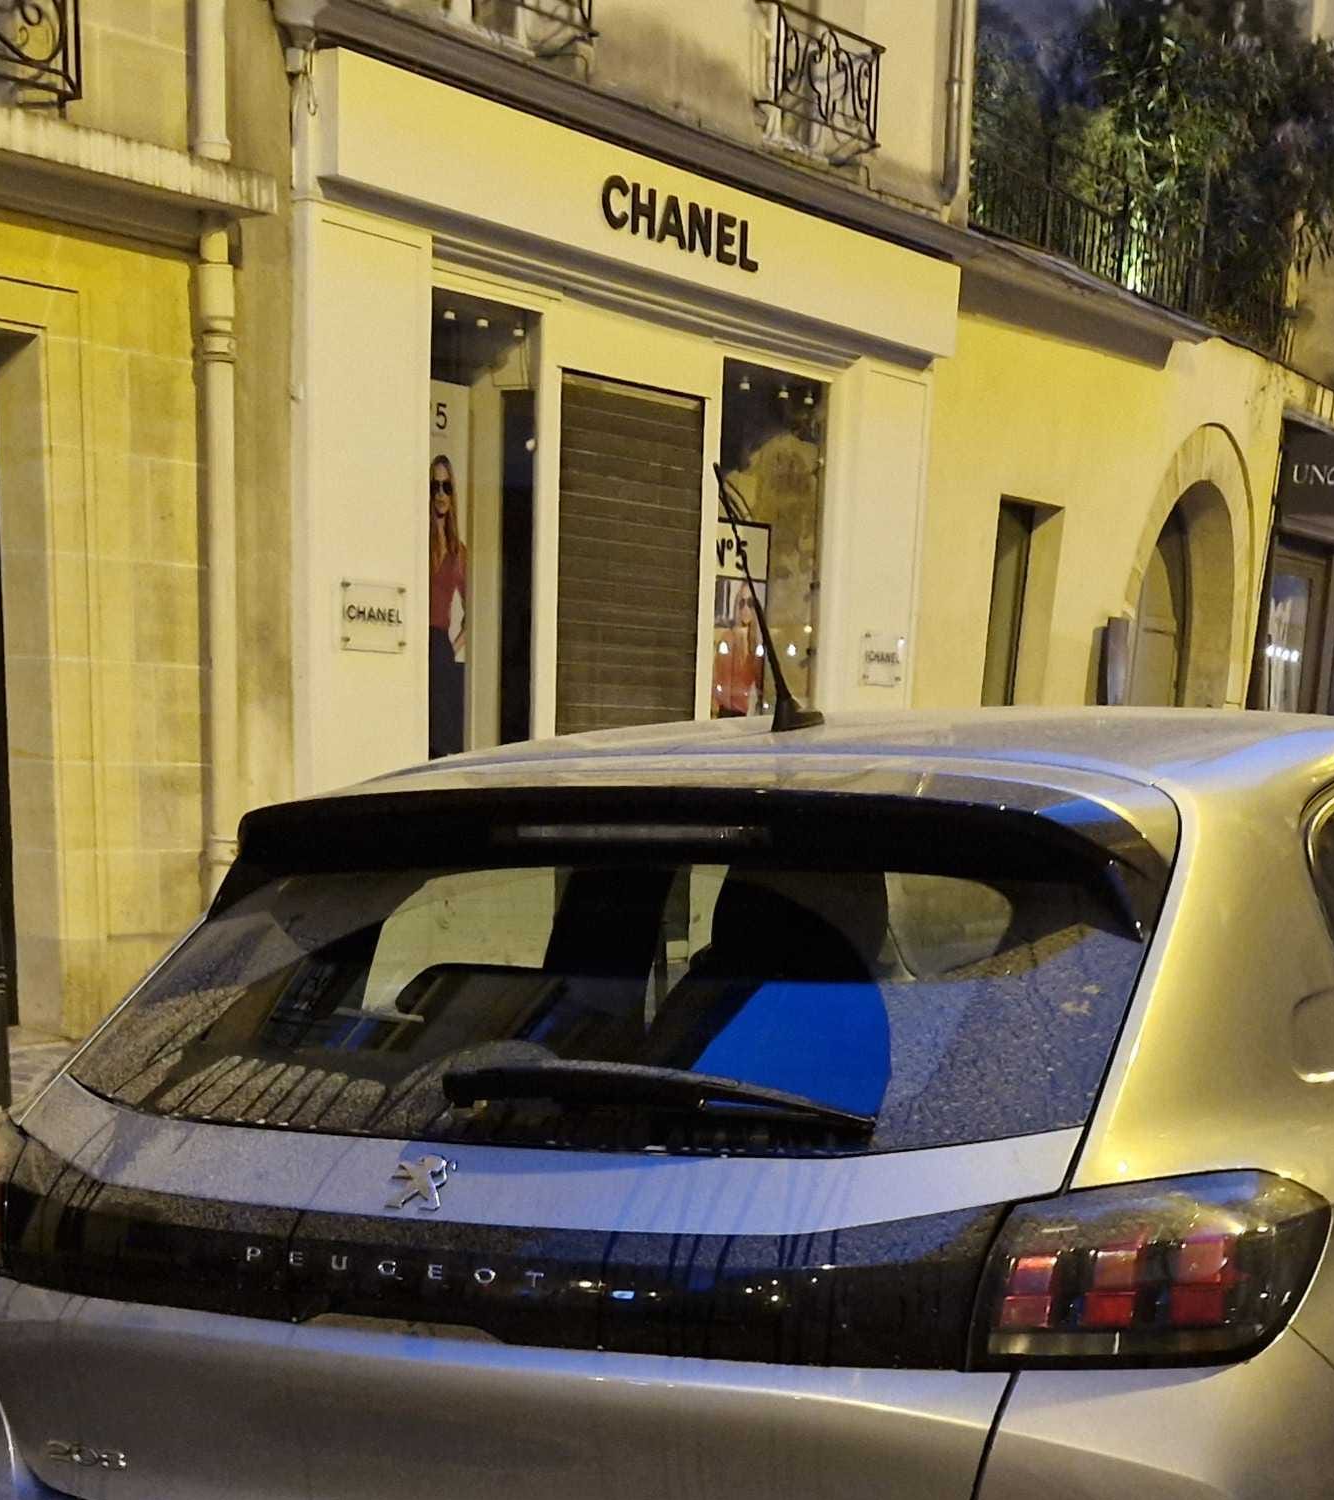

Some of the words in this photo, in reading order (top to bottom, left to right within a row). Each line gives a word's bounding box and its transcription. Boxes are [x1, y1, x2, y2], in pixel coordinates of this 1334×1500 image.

[601, 174, 759, 273] CHANEL
[346, 604, 403, 624] CHANEL
[246, 1246, 545, 1289] PEUGEOT
